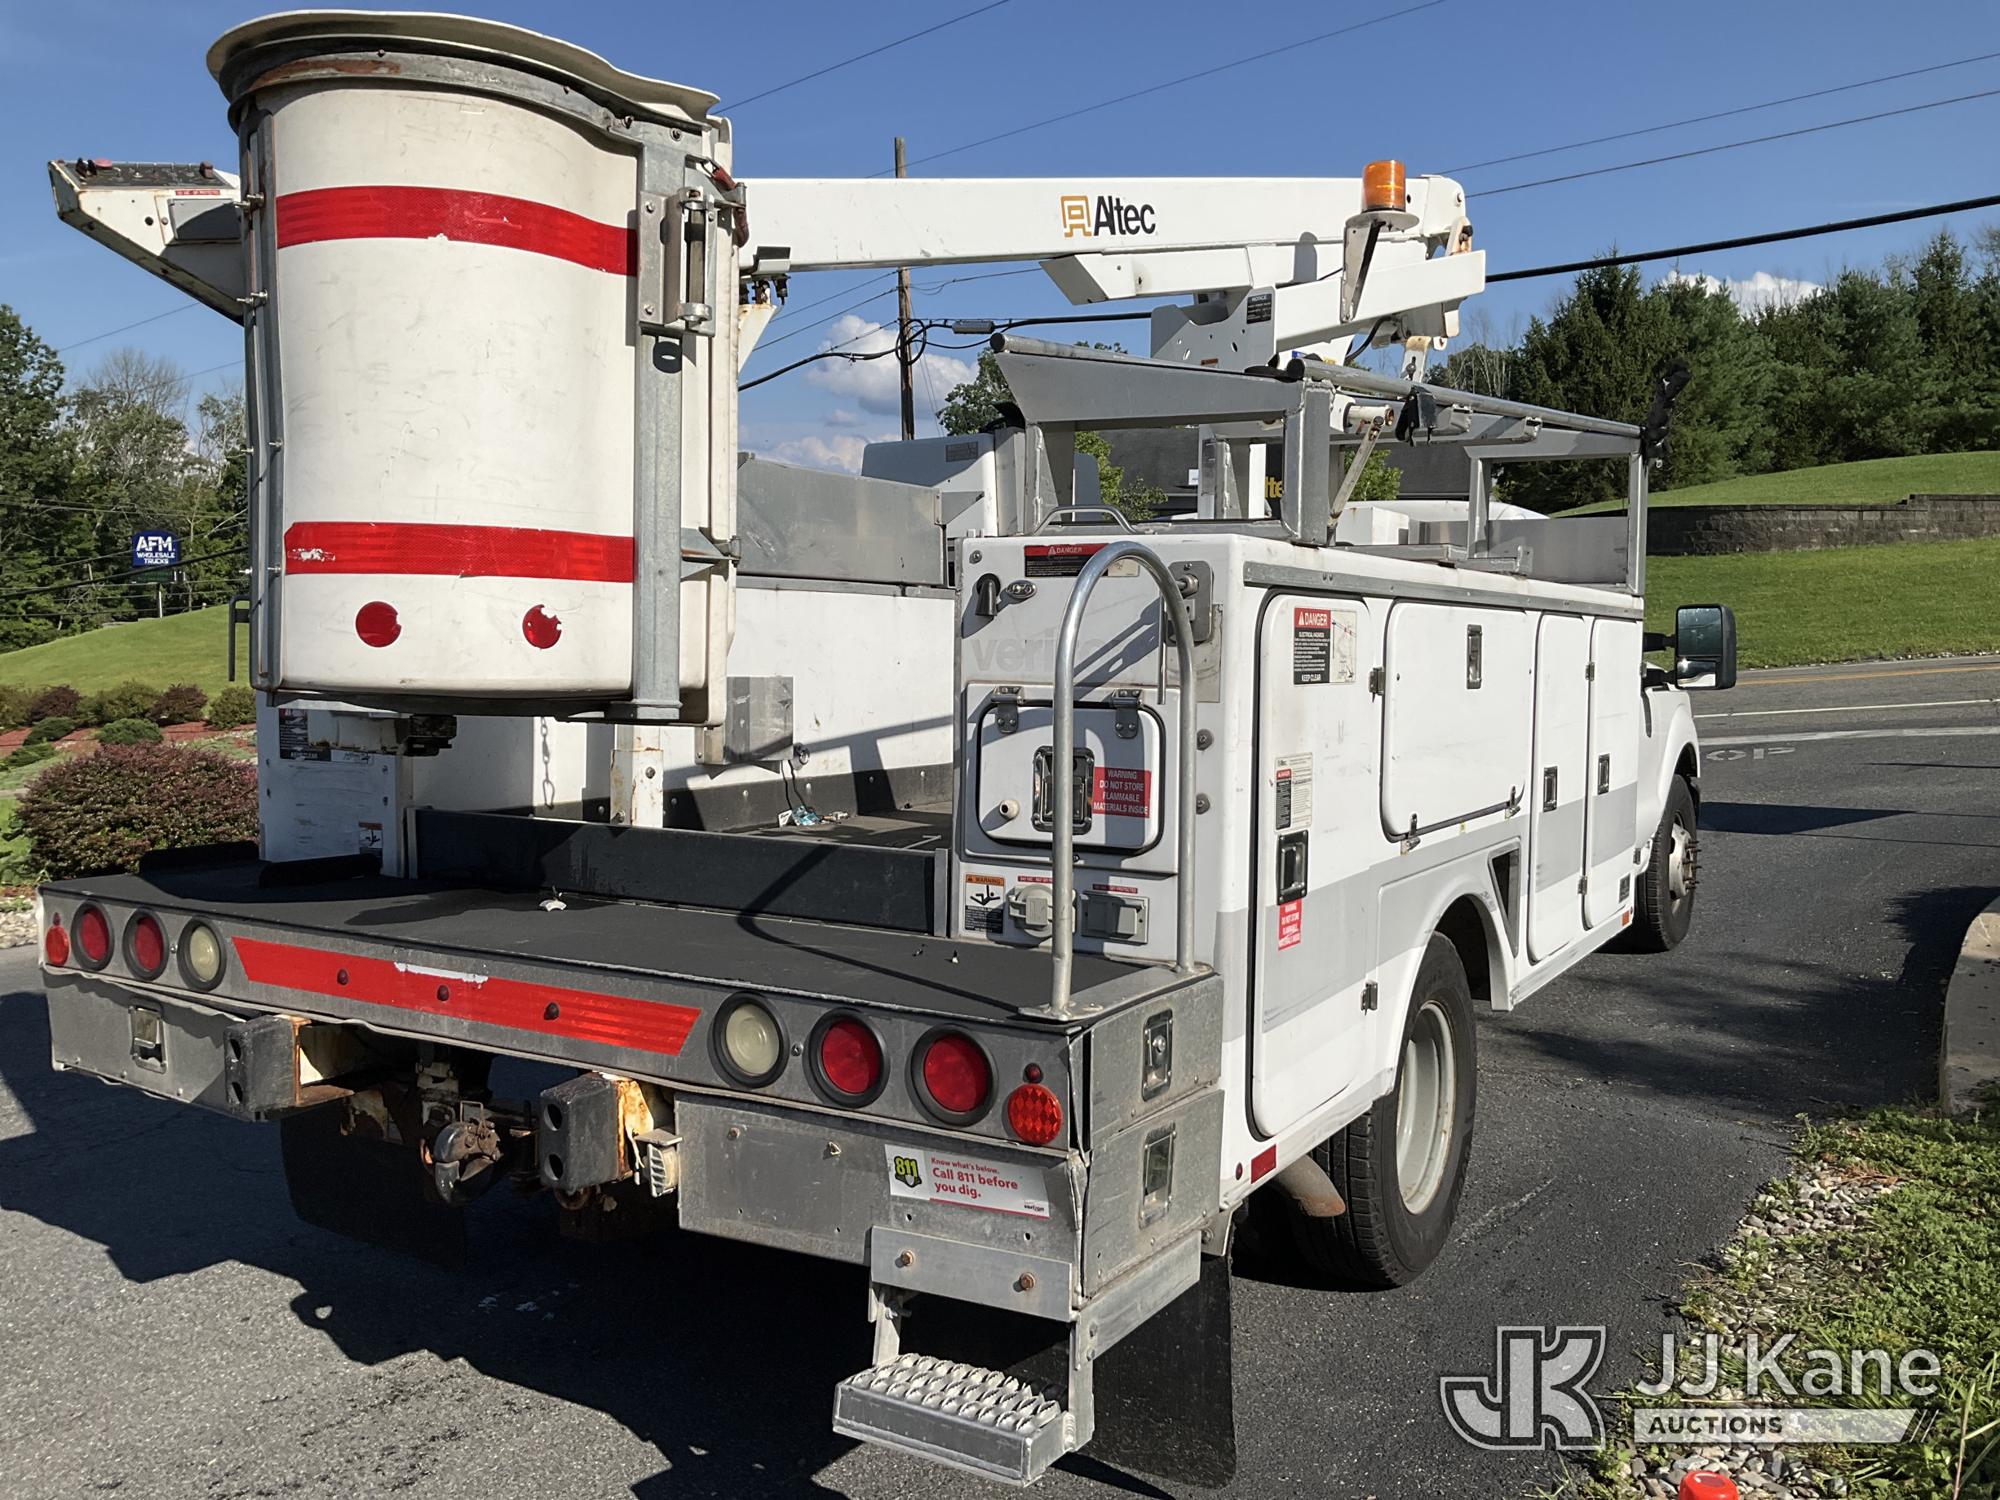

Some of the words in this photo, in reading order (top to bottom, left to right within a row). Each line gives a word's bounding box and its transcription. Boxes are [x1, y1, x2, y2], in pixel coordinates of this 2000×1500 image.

[1093, 195, 1156, 236] Altec
[1304, 612, 1328, 626] DANGER
[1107, 769, 1137, 780] WARNING
[1100, 779, 1109, 789] DO
[1109, 780, 1124, 790] NOT
[1124, 781, 1145, 792] STORE
[1103, 791, 1140, 803] FLAMMABLE
[1093, 801, 1127, 813] MATERIALS
[1128, 804, 1148, 815] INSIDE
[975, 877, 1002, 886] WARNING
[894, 1156, 918, 1176] 811
[931, 1157, 951, 1166] Know
[952, 1158, 975, 1171] what's
[976, 1163, 1000, 1174] below.
[932, 1167, 954, 1180] Call
[957, 1171, 975, 1183] 811
[978, 1174, 1018, 1190] before
[934, 1181, 956, 1193] you
[958, 1185, 982, 1199] dig.
